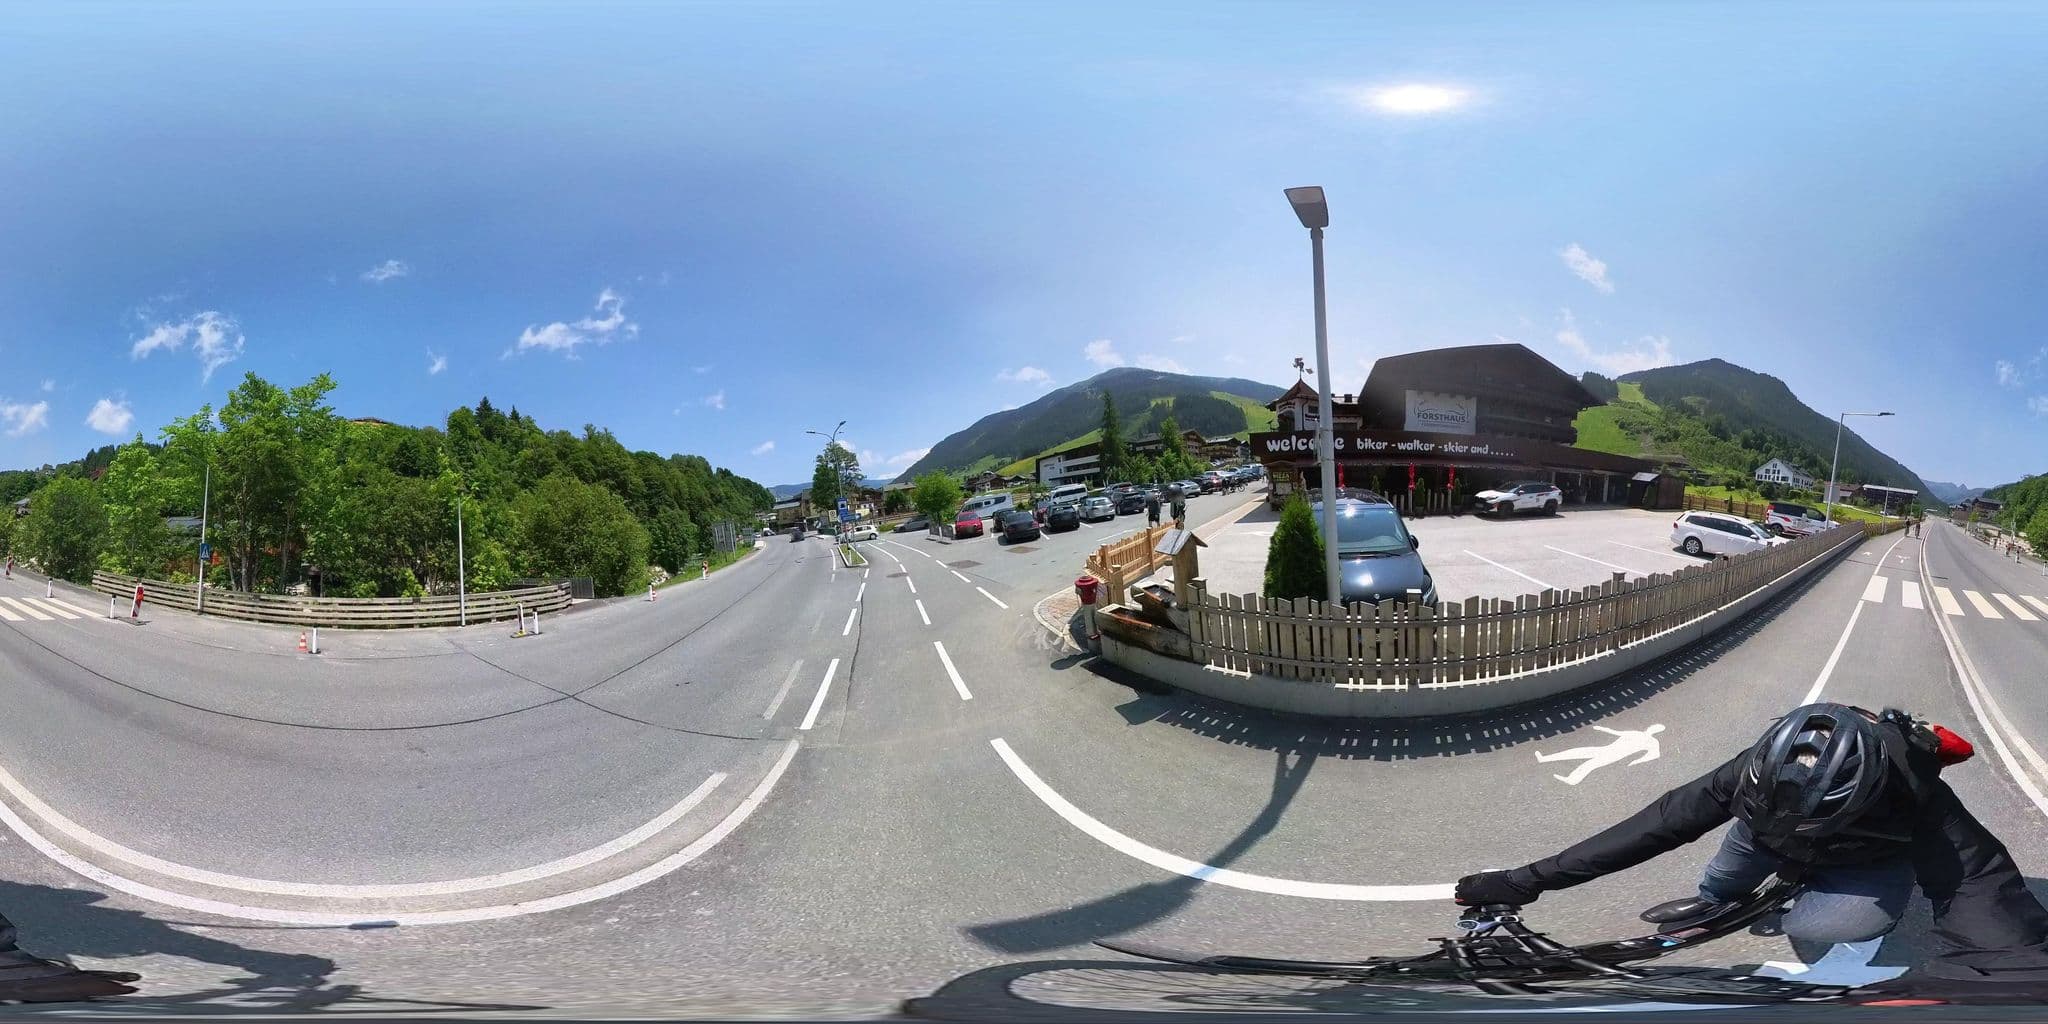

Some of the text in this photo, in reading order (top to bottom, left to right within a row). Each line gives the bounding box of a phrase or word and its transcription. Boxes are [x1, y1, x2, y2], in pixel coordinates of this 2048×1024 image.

[1417, 412, 1466, 423] FORSTHAUS
[1266, 435, 1345, 452] welcoe
[1356, 438, 1388, 450] biker
